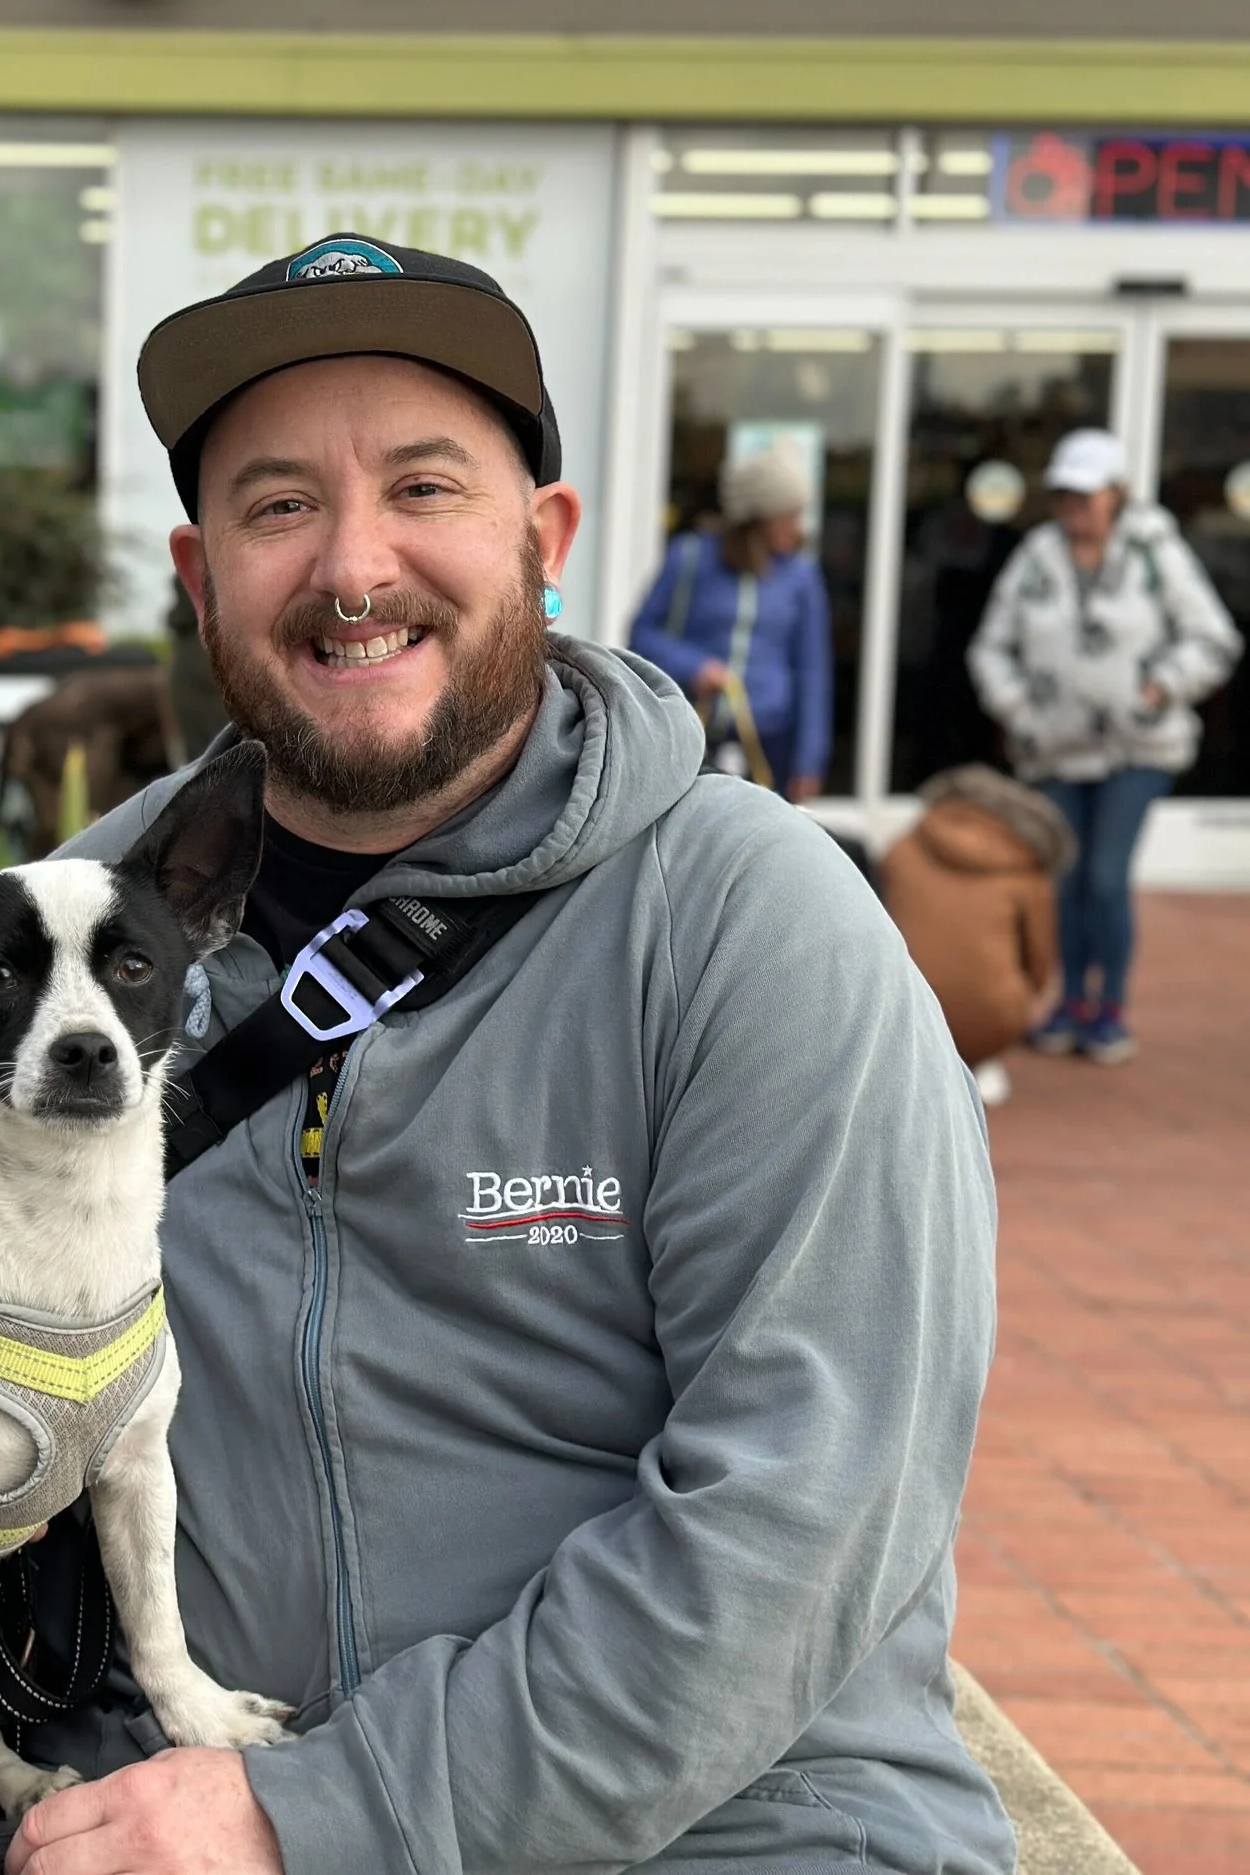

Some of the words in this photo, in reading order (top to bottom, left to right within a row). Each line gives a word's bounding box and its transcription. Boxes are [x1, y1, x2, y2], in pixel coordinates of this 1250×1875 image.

[194, 160, 297, 193] FREE
[193, 203, 541, 257] DELIVERY
[389, 897, 448, 940] HROME
[466, 1165, 621, 1213] Bernie
[528, 1225, 578, 1246] 2020
